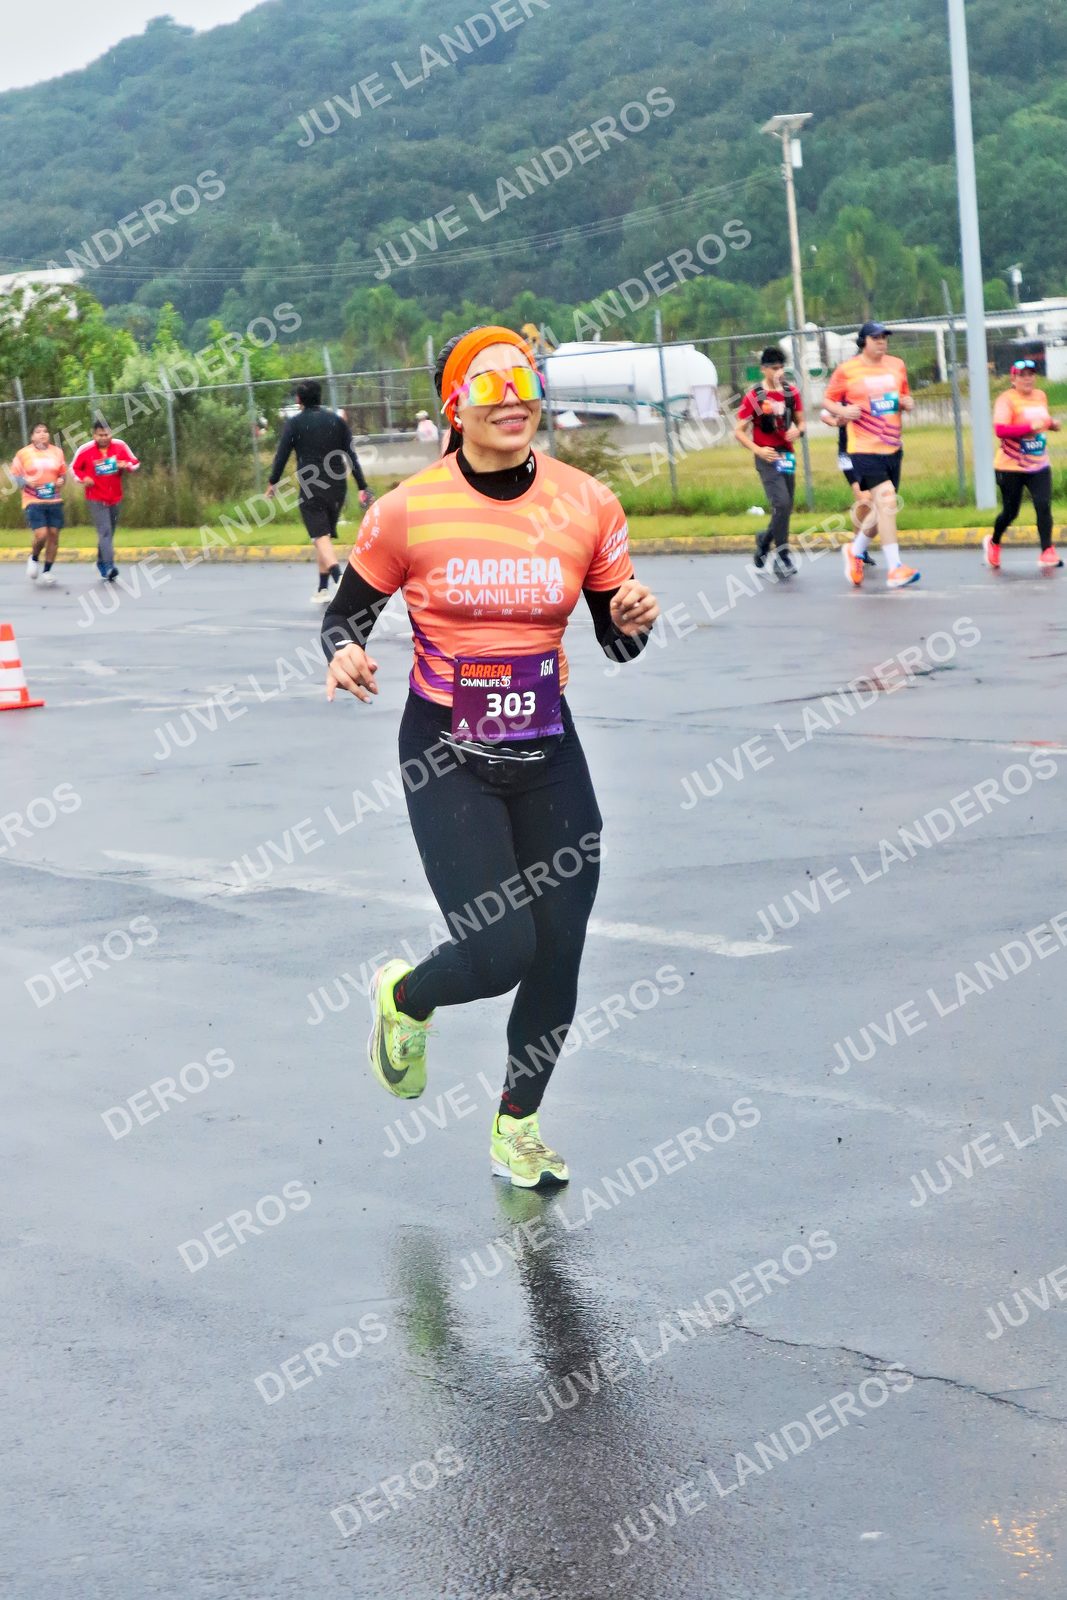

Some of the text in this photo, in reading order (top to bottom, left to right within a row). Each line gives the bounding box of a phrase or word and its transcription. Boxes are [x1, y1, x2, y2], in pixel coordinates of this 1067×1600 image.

[446, 557, 563, 585] CARRERA
[446, 589, 541, 605] OMNILIFE
[461, 664, 512, 678] CARRERA
[540, 658, 554, 676] 15K
[460, 678, 500, 687] OMNILIFE
[486, 691, 536, 717] 303
